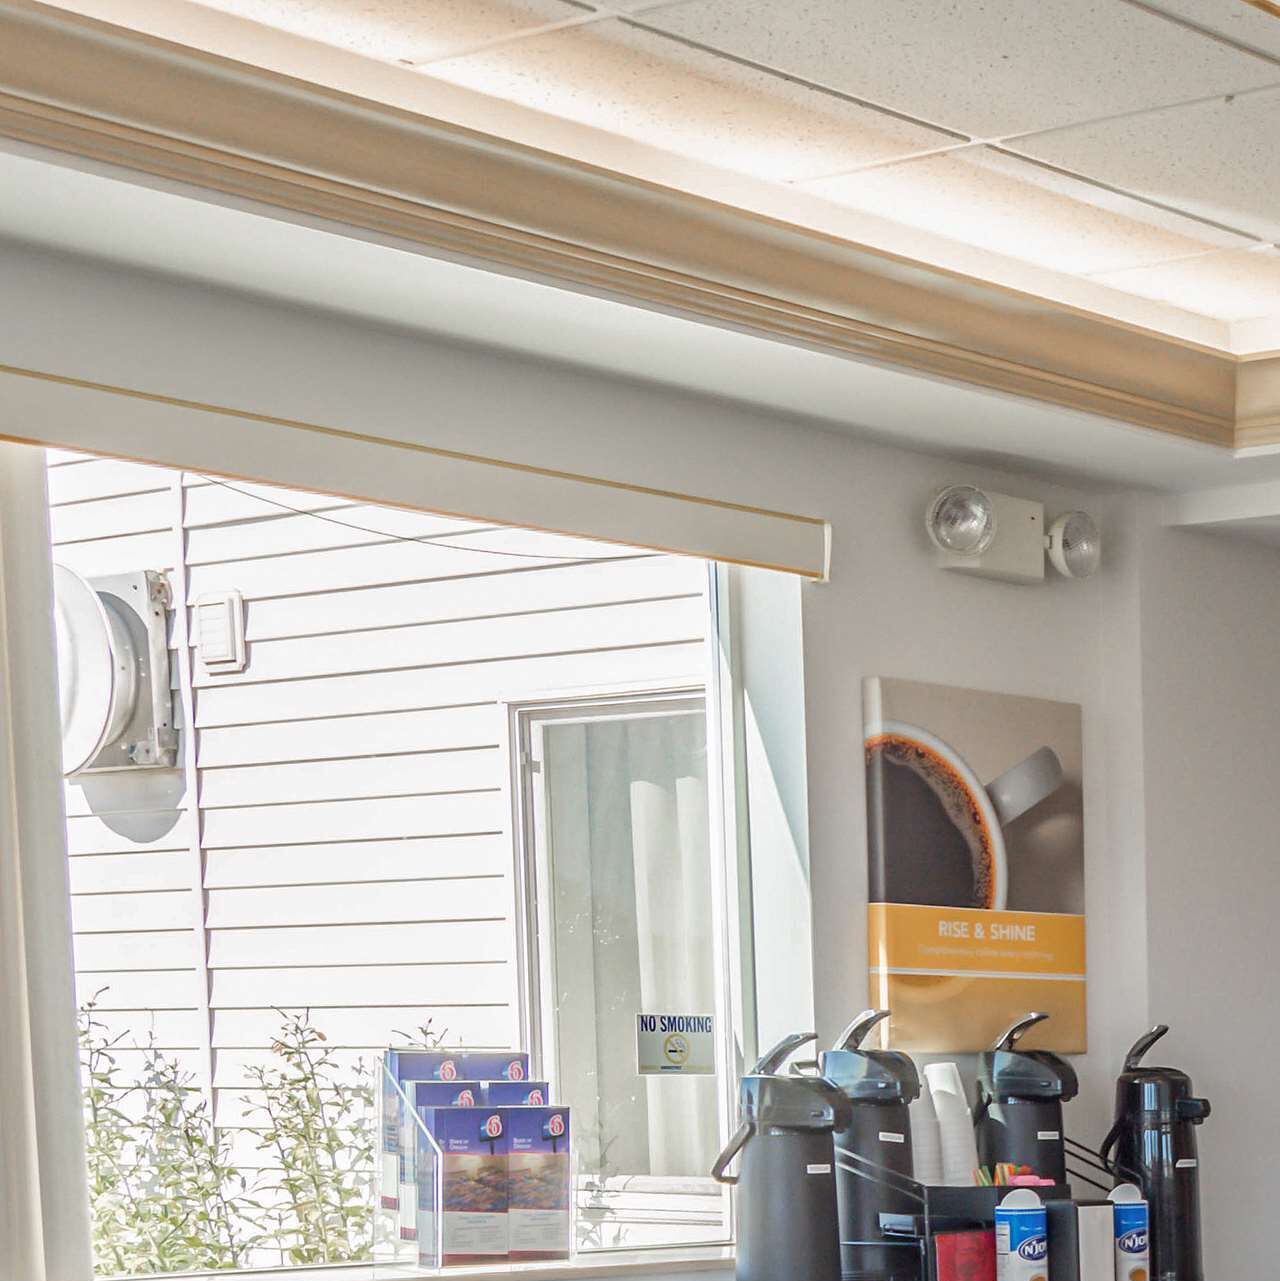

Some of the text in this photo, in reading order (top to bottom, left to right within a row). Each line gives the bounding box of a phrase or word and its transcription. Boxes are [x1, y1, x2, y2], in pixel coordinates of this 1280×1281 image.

[938, 920, 1036, 942] RISE & SHINE
[640, 1015, 712, 1033] NO SMOKING
[439, 1060, 457, 1081] 6
[507, 1060, 524, 1081] 6
[486, 1114, 502, 1137] 6
[549, 1113, 565, 1136] 6
